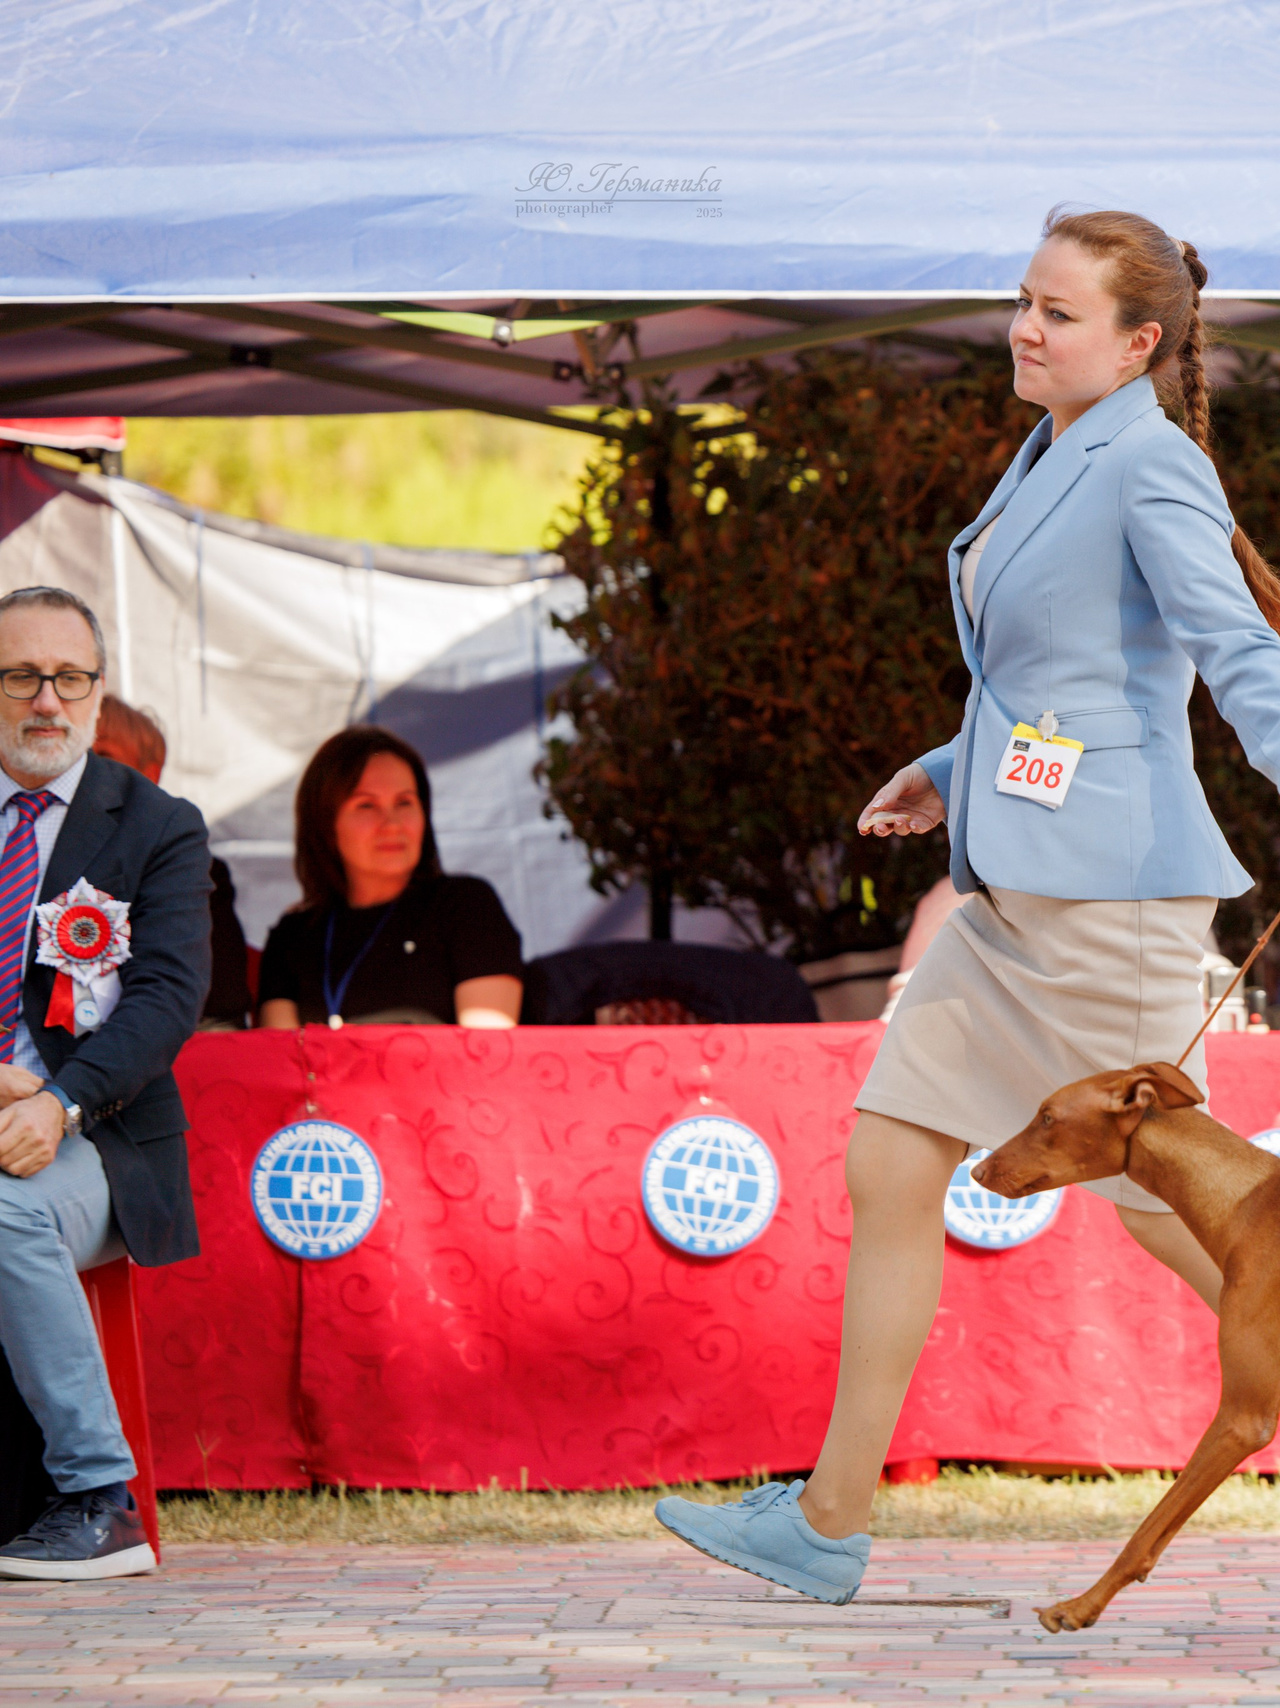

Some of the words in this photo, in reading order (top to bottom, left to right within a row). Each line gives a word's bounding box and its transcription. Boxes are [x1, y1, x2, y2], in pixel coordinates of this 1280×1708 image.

[1006, 754, 1064, 789] 208
[291, 1174, 343, 1205] FCI
[684, 1167, 739, 1201] FCI
